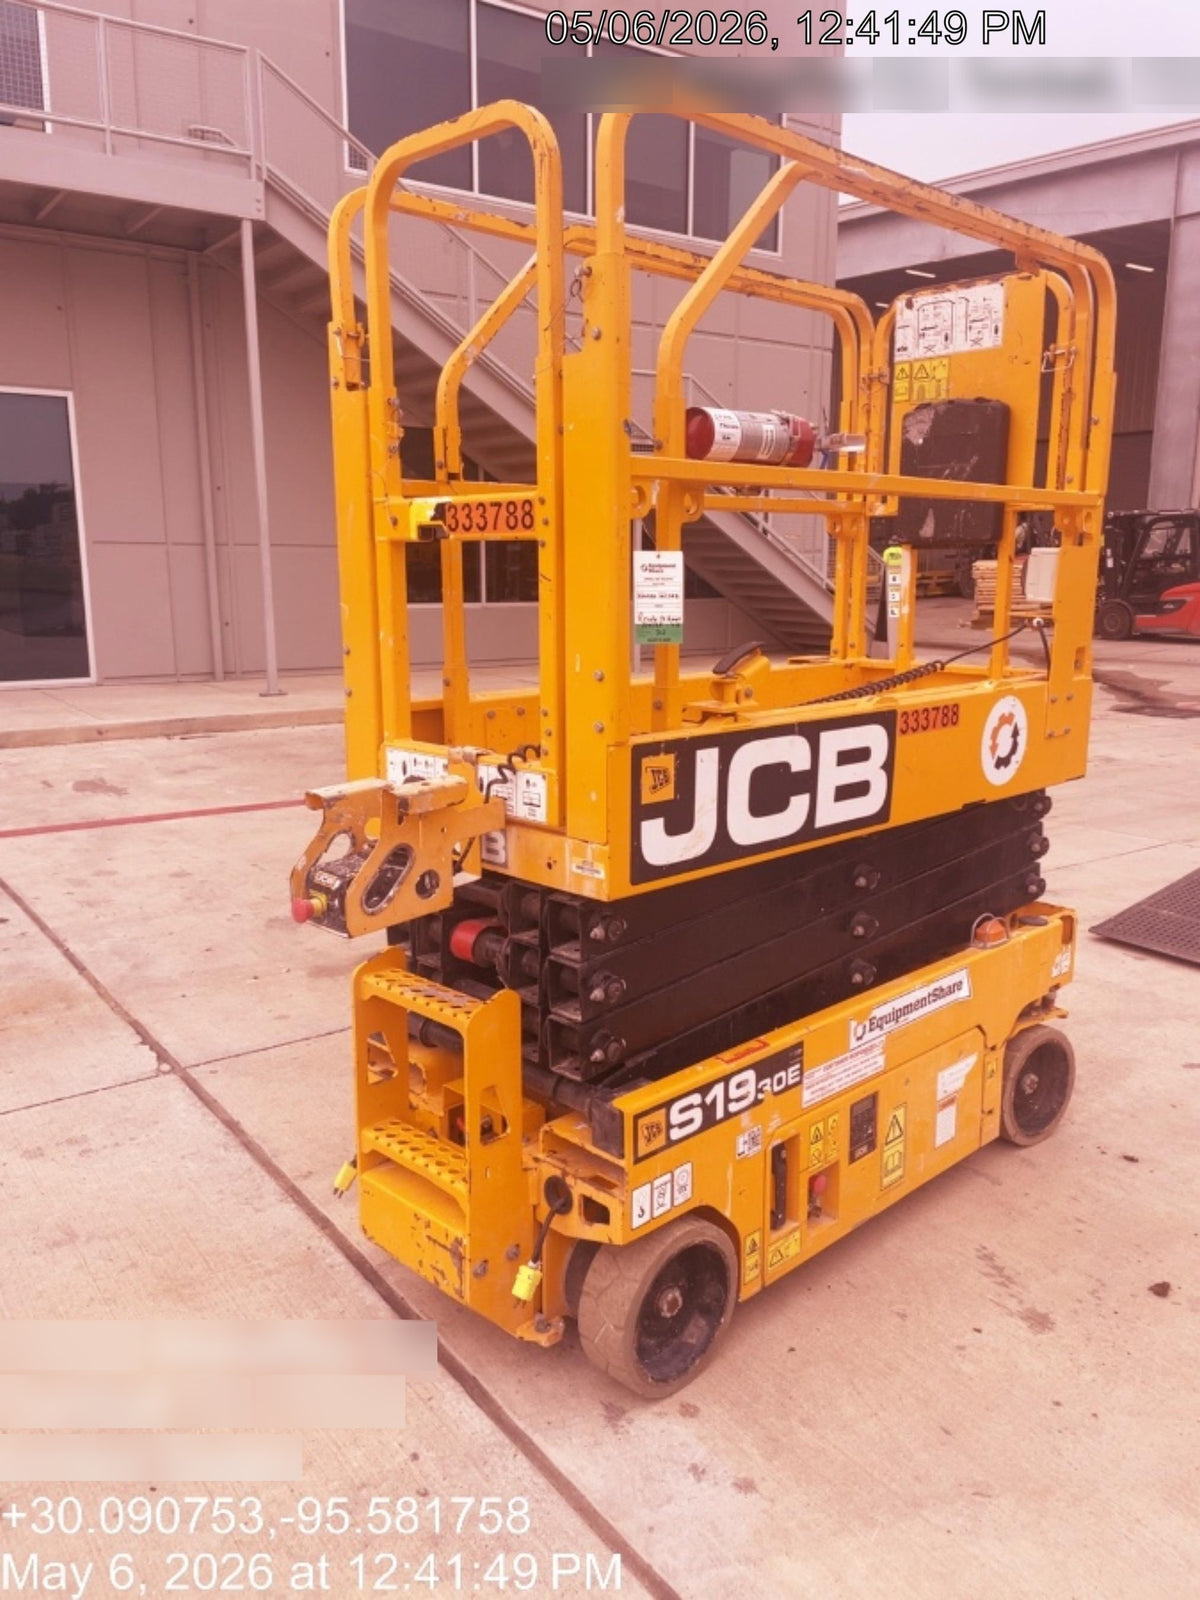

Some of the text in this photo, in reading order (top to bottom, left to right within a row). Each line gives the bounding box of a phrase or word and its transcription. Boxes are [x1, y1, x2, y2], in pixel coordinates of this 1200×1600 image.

[447, 499, 535, 532] 333788
[900, 704, 959, 734] 333788
[641, 724, 889, 866] JCB
[868, 980, 963, 1033] EquipmentShare
